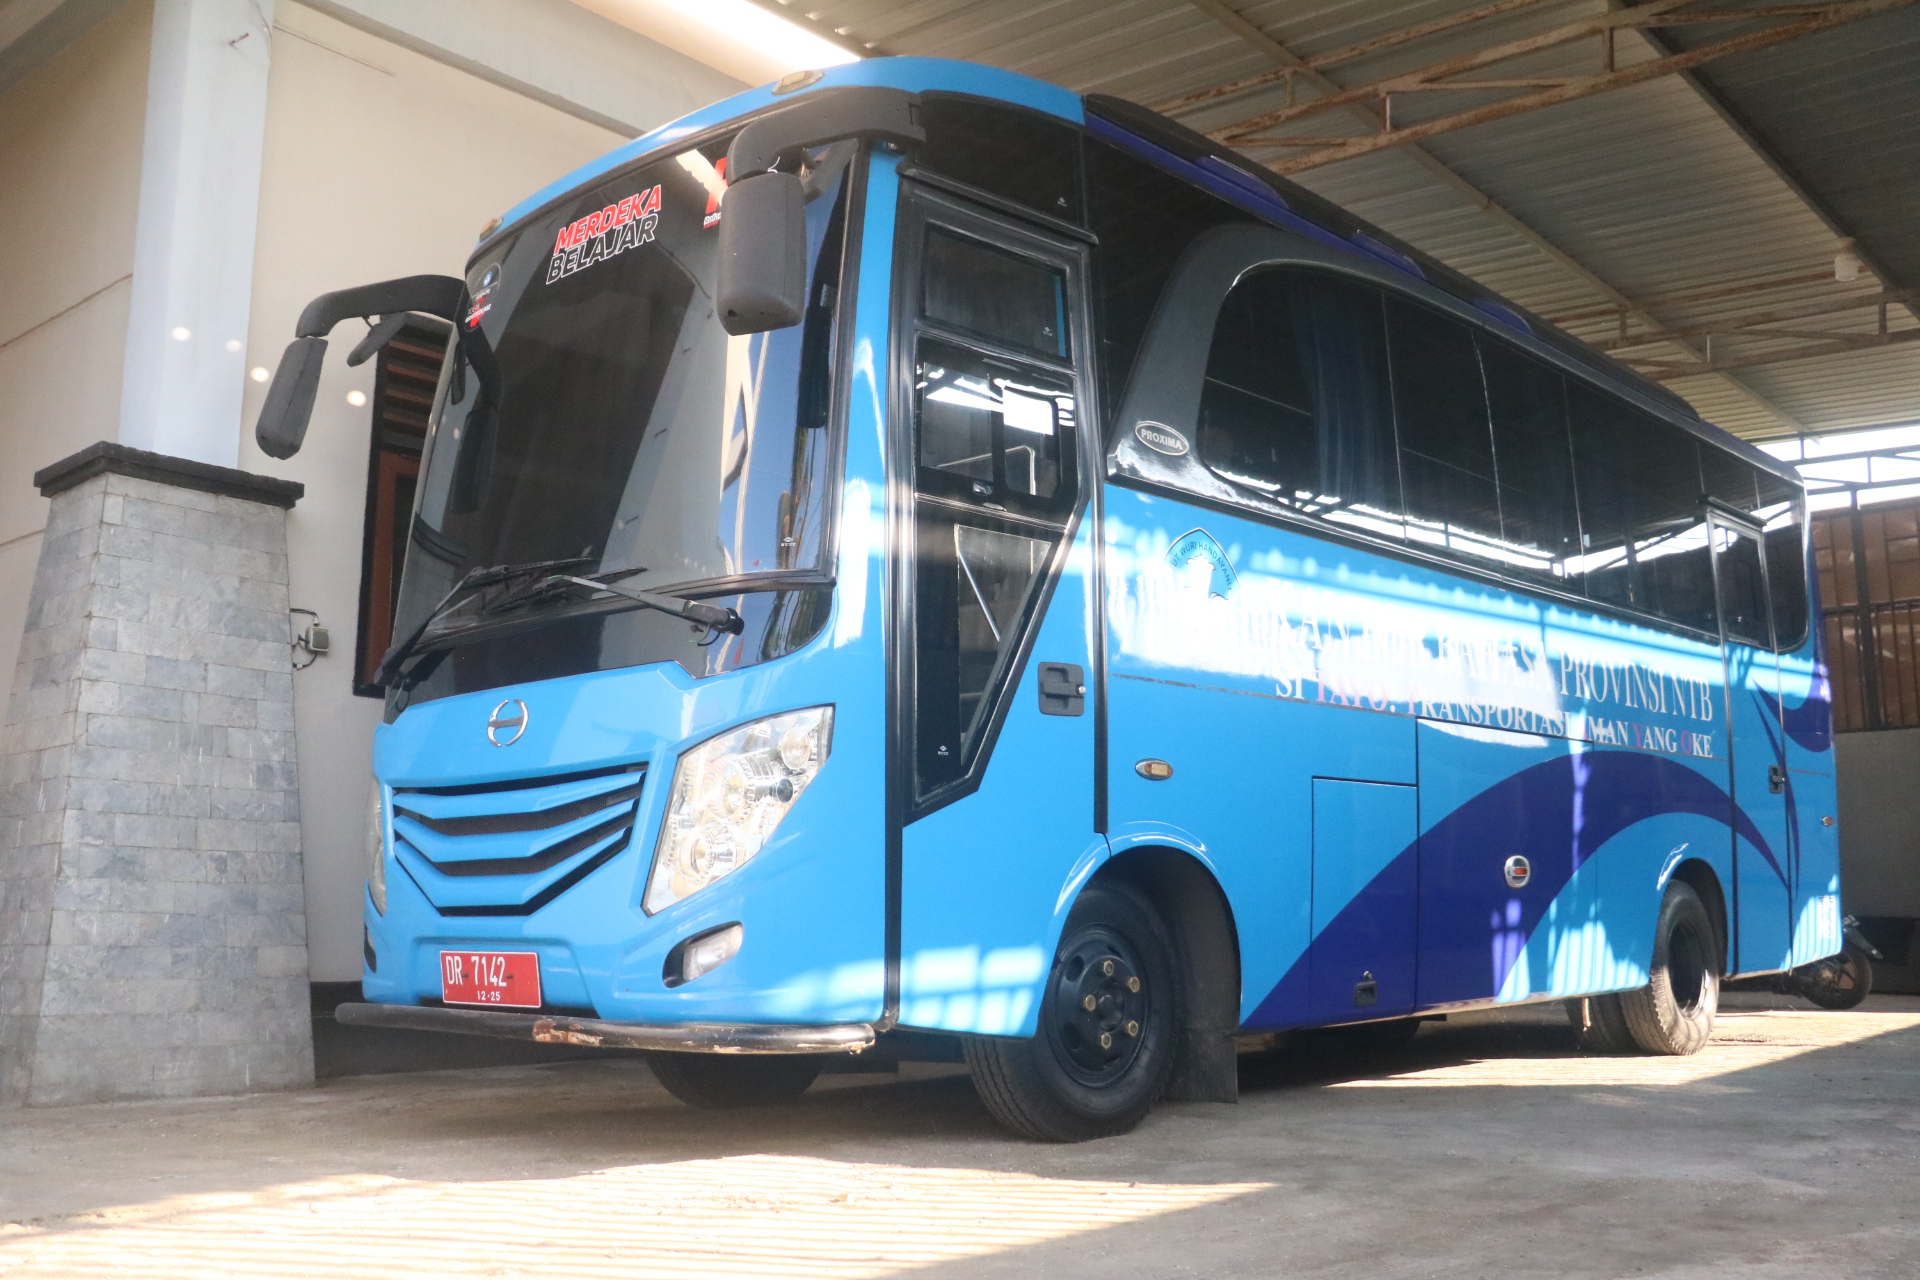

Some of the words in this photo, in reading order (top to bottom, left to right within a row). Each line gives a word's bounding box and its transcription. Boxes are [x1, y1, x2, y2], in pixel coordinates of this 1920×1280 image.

[546, 213, 658, 285] BELAJAR
[554, 184, 661, 254] MERDEKA
[1141, 428, 1182, 450] PROXIMA
[1179, 541, 1197, 556] WURI
[1198, 541, 1232, 586] HANDAYANI
[1276, 665, 1305, 700] SI
[1631, 722, 1677, 753] YANG
[1681, 730, 1713, 758] OKE
[1559, 648, 1667, 714] PROVINSI
[1669, 669, 1713, 721] NTB
[445, 956, 463, 985] DR
[471, 956, 507, 987] 7142
